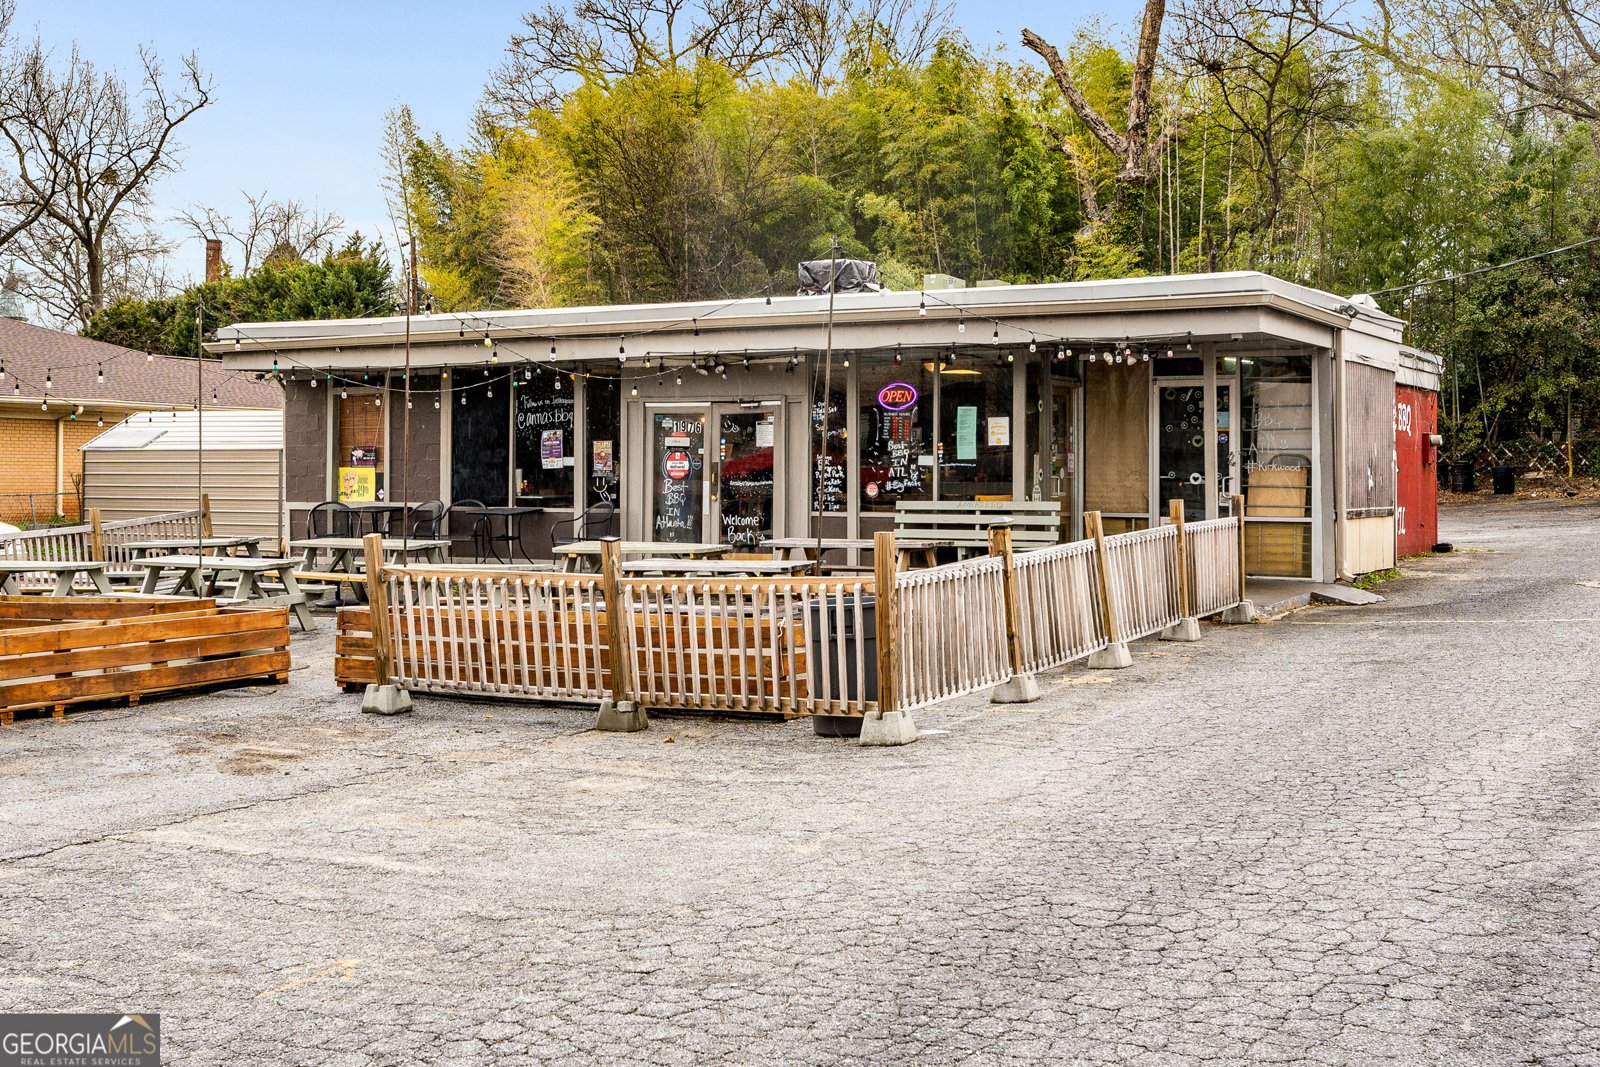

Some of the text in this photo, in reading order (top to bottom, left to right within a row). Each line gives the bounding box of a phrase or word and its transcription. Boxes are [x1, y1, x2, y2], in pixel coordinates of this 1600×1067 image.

[881, 390, 913, 403] OPEN
[1397, 402, 1411, 437] BBQ
[674, 421, 702, 433] 1976
[1248, 442, 1278, 456] ATL
[888, 467, 909, 478] ATL
[662, 478, 689, 494] Best
[665, 492, 687, 506] BBQ
[666, 507, 681, 517] IN
[721, 513, 760, 526] Welcome
[727, 525, 756, 546] Back
